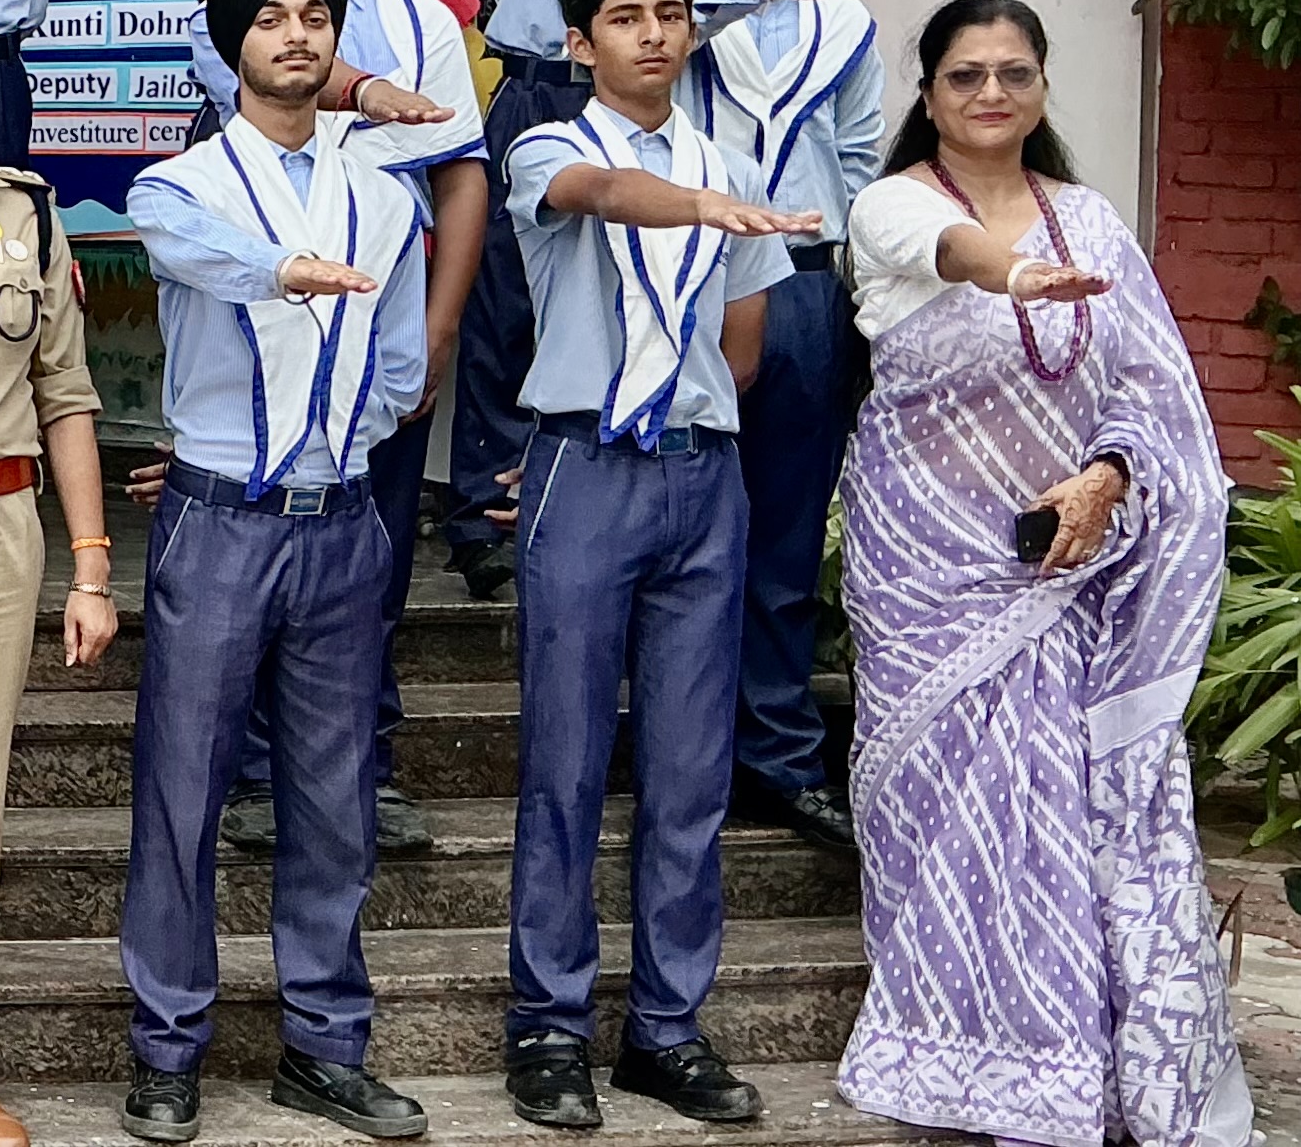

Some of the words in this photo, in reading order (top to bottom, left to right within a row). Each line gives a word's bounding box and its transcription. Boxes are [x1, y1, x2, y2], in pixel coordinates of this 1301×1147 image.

[118, 10, 190, 37] Dohr
[27, 73, 111, 100] Deputy
[31, 119, 140, 144] nvestiture
[149, 124, 187, 142] cer
